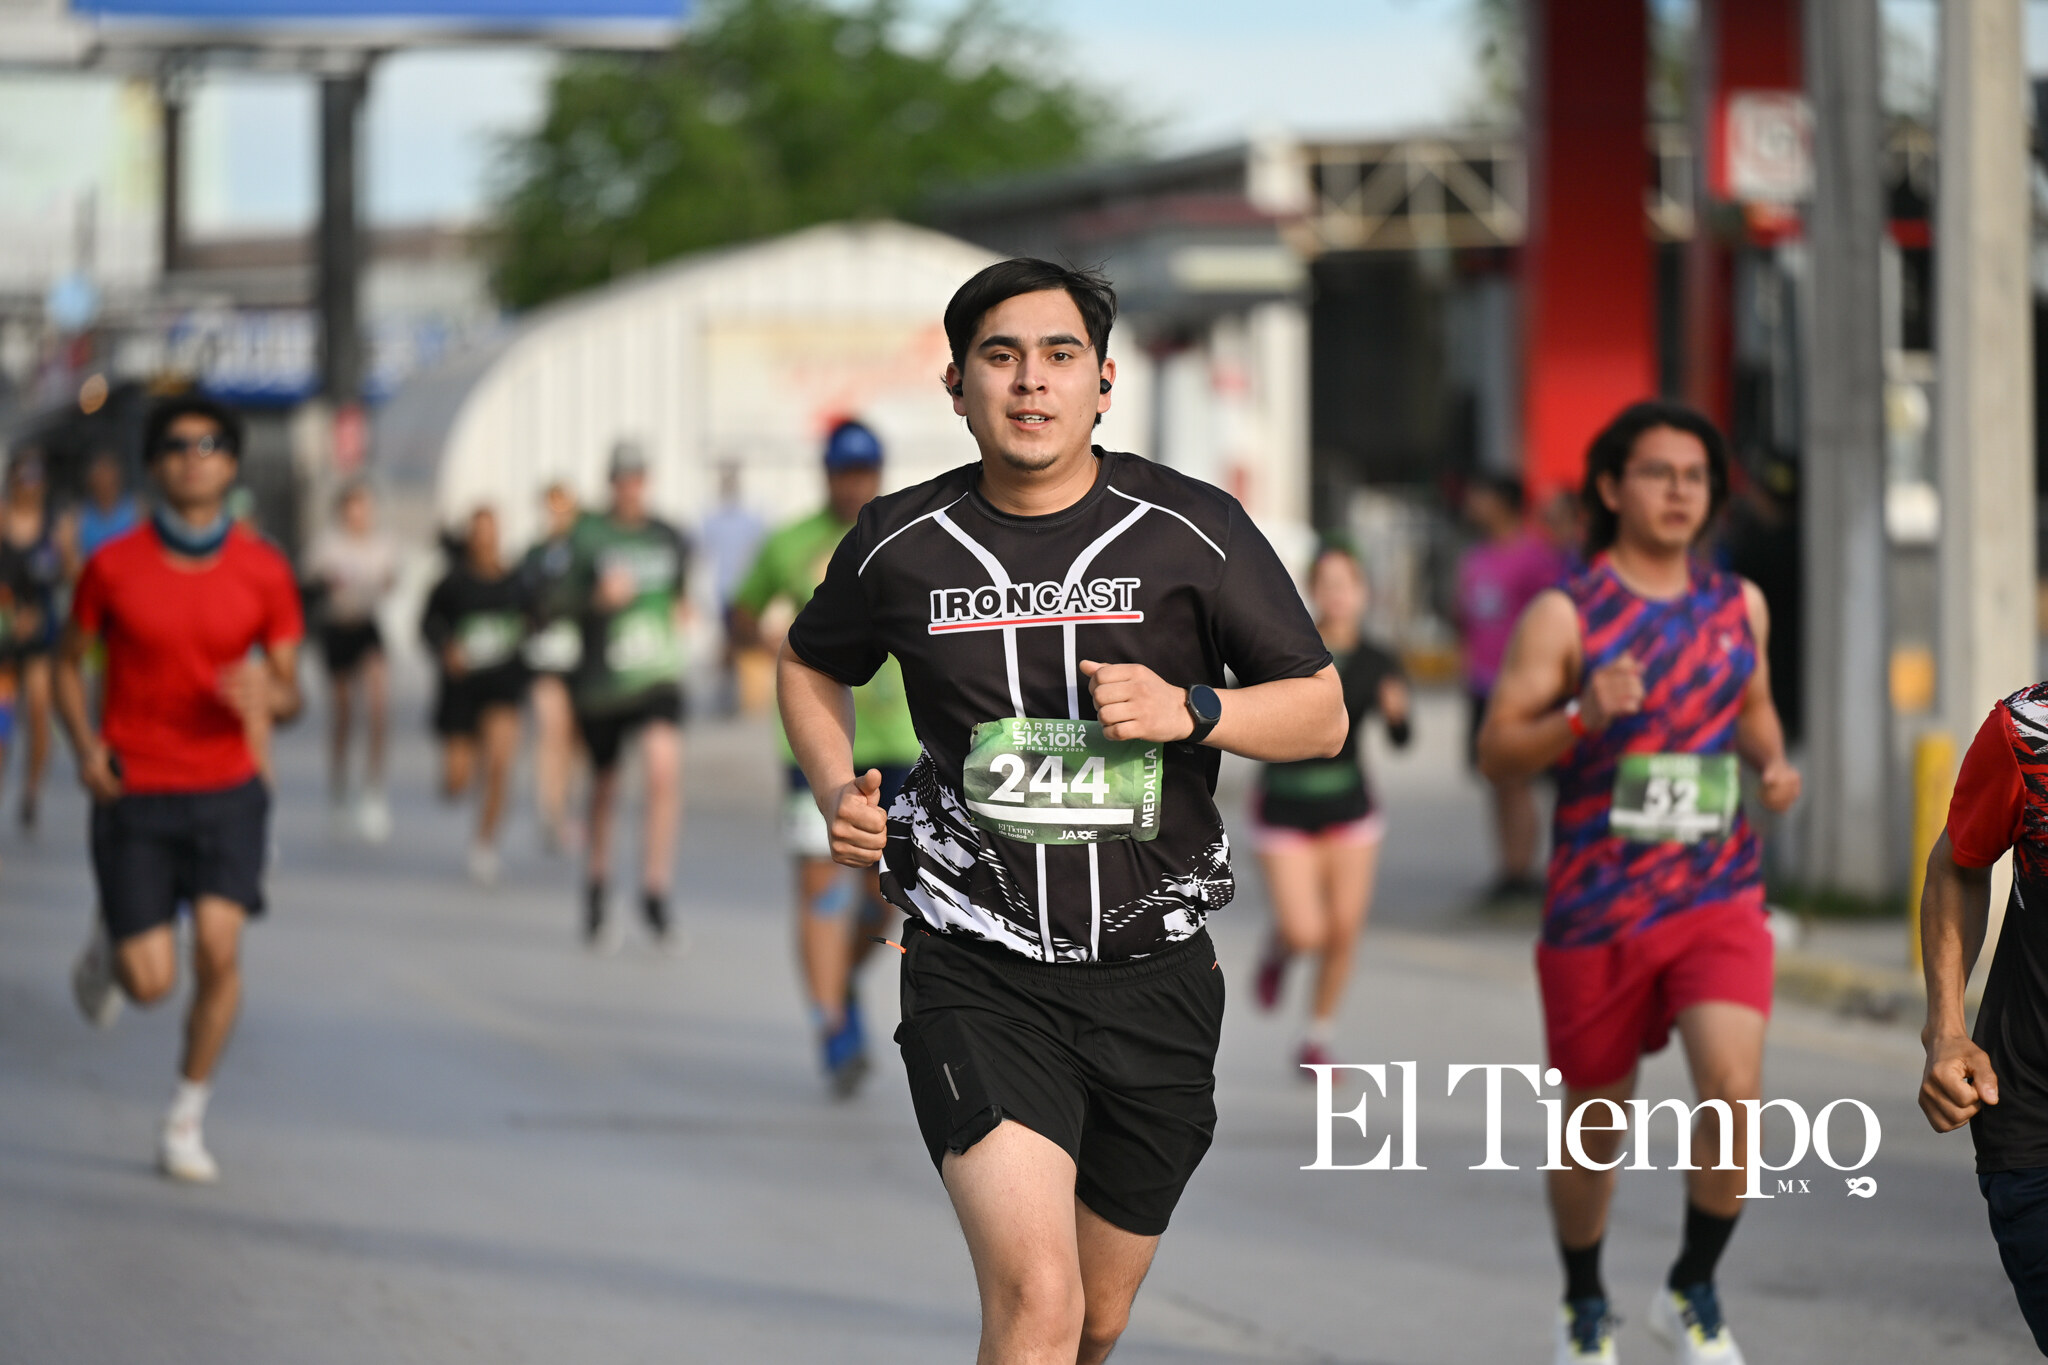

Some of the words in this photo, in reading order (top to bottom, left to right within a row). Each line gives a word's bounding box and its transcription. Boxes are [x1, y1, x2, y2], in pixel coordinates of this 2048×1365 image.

[930, 578, 1141, 622] IRONCAST
[1012, 721, 1087, 733] CARRERA
[988, 753, 1110, 805] 244
[1141, 748, 1158, 829] MEDALLA
[1006, 824, 1035, 837] Tiempo
